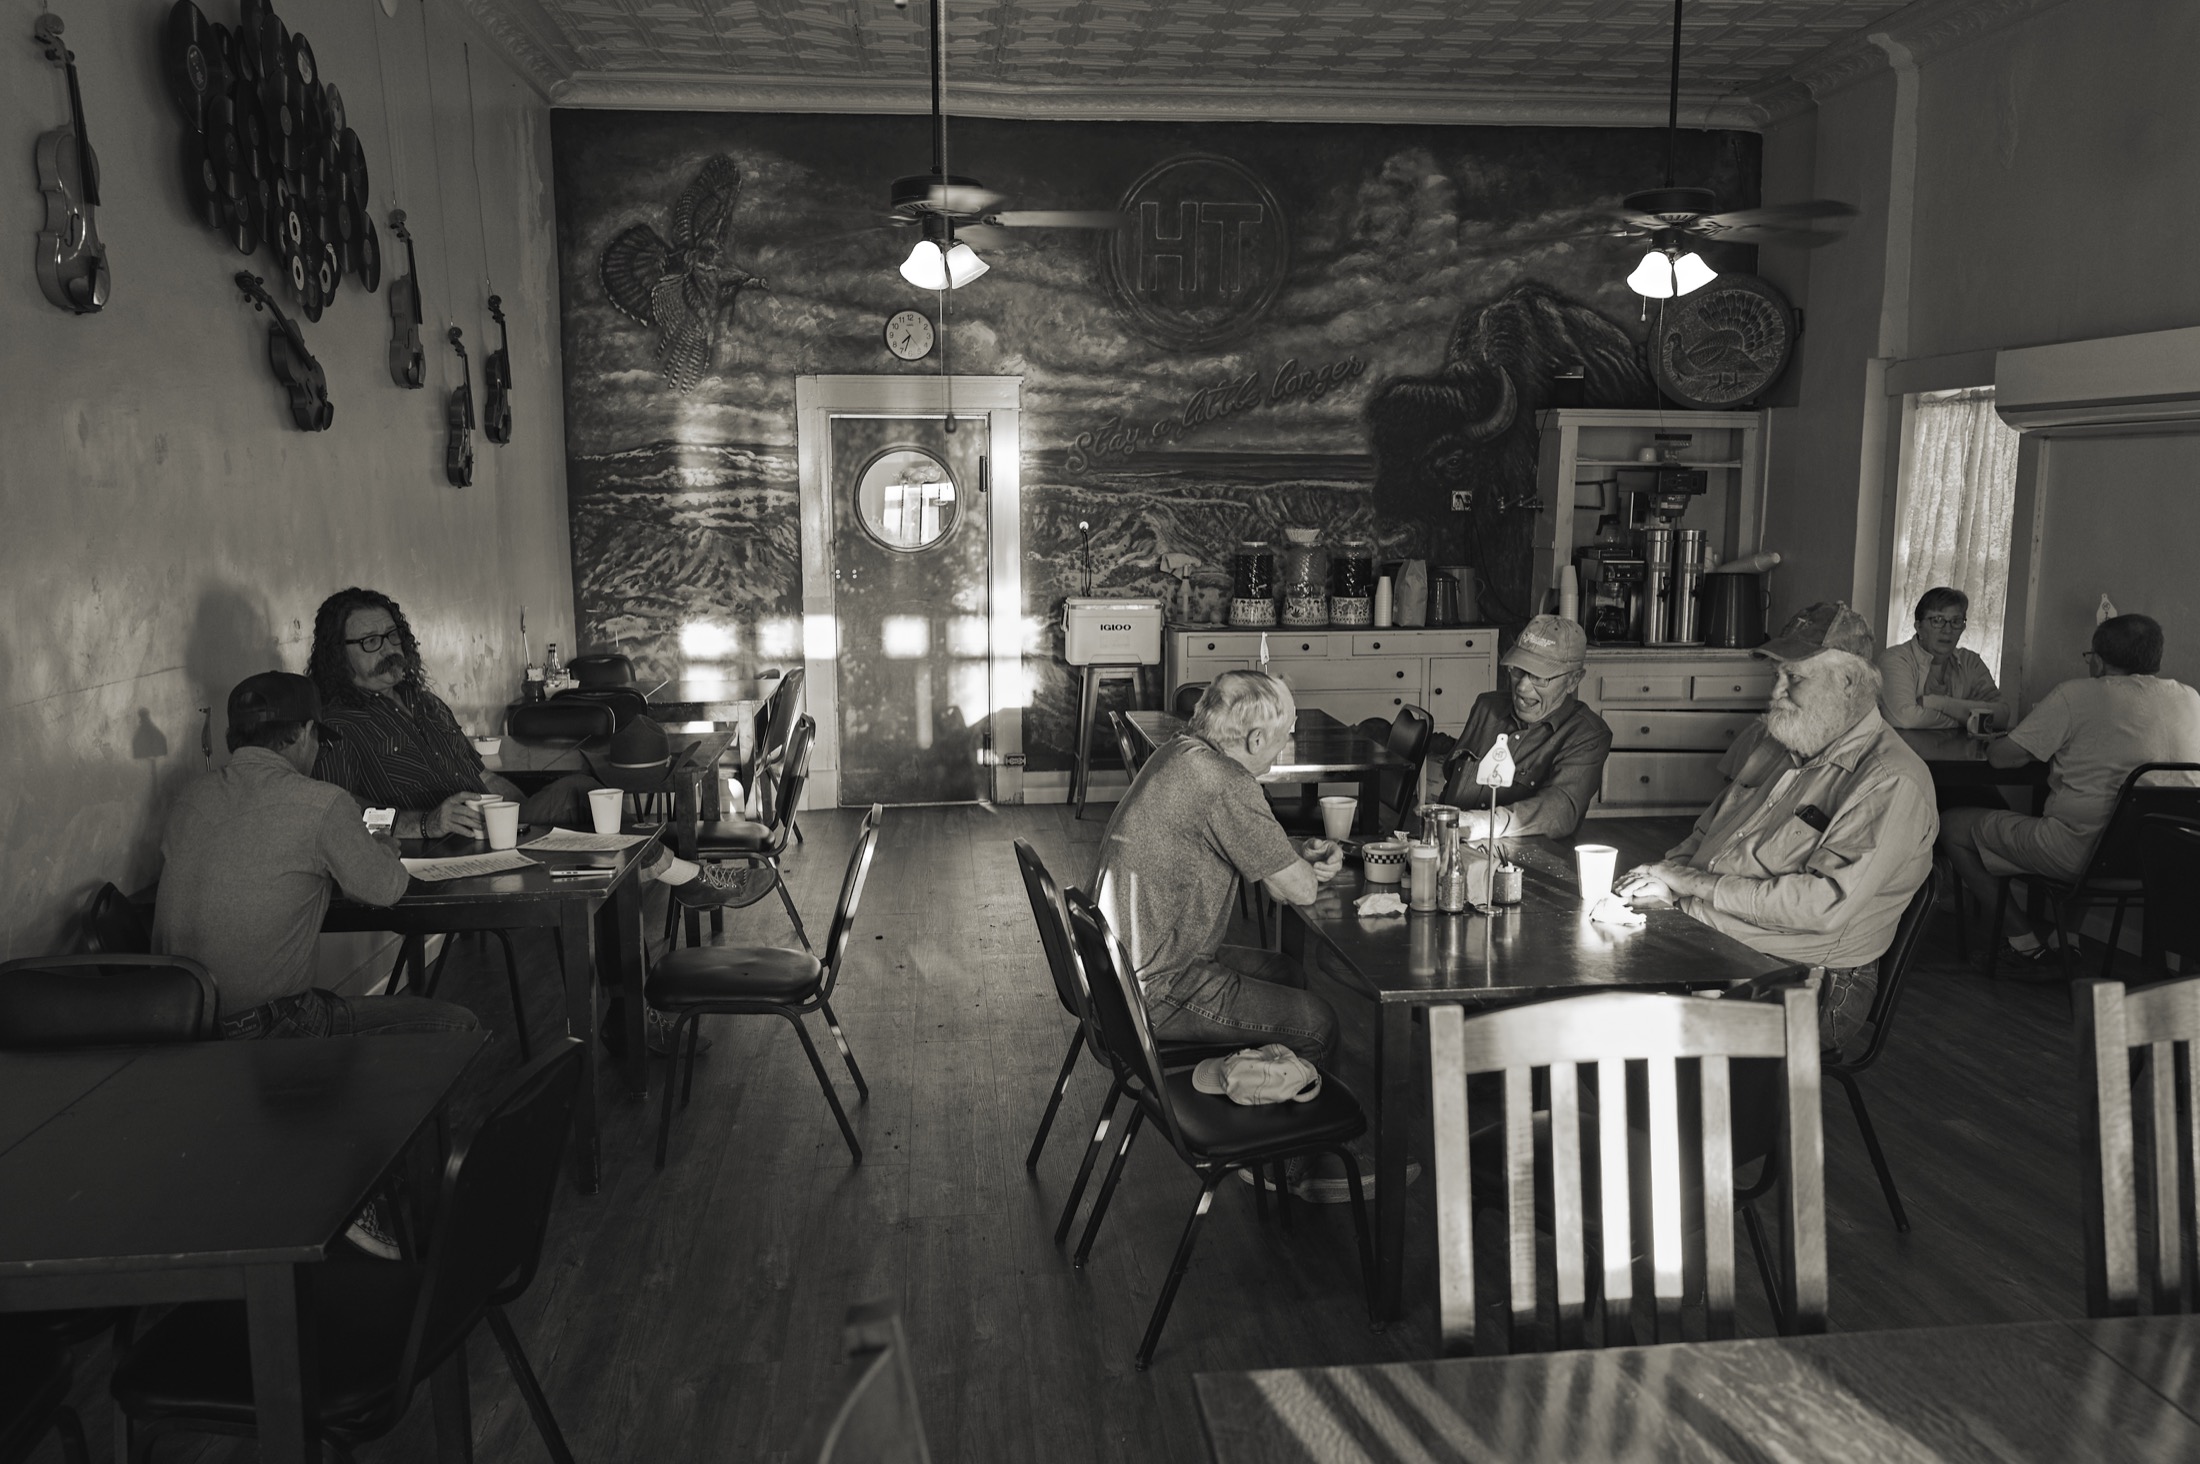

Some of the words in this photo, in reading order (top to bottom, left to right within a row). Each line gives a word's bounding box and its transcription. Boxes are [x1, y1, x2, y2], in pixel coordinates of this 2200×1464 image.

[1139, 200, 1263, 293] HT
[1065, 417, 1140, 475] Stay
[1152, 419, 1174, 438] a
[1181, 371, 1262, 429] little
[1270, 355, 1368, 400] longer
[1100, 623, 1132, 631] IGLOO
